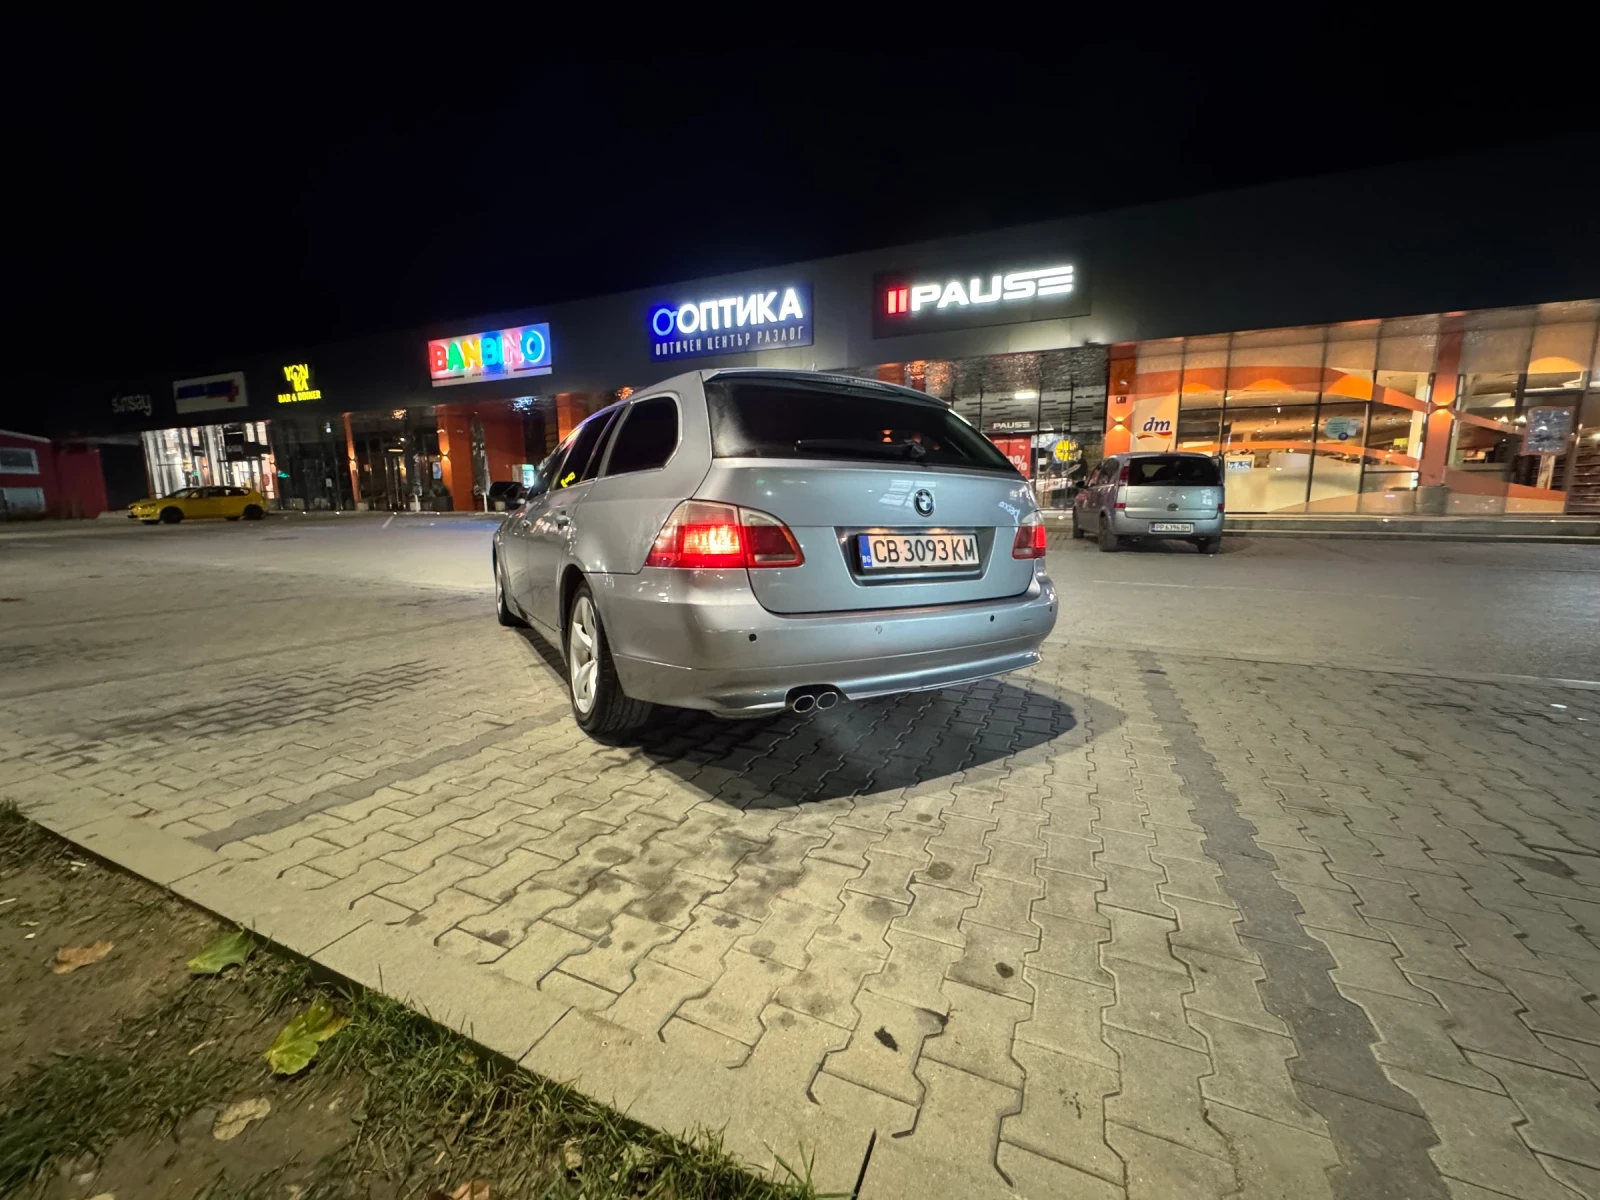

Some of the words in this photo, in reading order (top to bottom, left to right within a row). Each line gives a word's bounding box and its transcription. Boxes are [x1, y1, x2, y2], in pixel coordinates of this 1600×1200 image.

[911, 265, 1073, 312] PAUSE
[676, 288, 803, 334] ОПТИКА
[430, 330, 545, 373] BAMBINO
[655, 338, 702, 356] ОПТИЧЕН
[707, 332, 750, 350] ЦЕНТЪР
[757, 326, 804, 344] РАЗЛОГ
[993, 421, 1030, 430] PAUSE
[1143, 417, 1171, 432] dm
